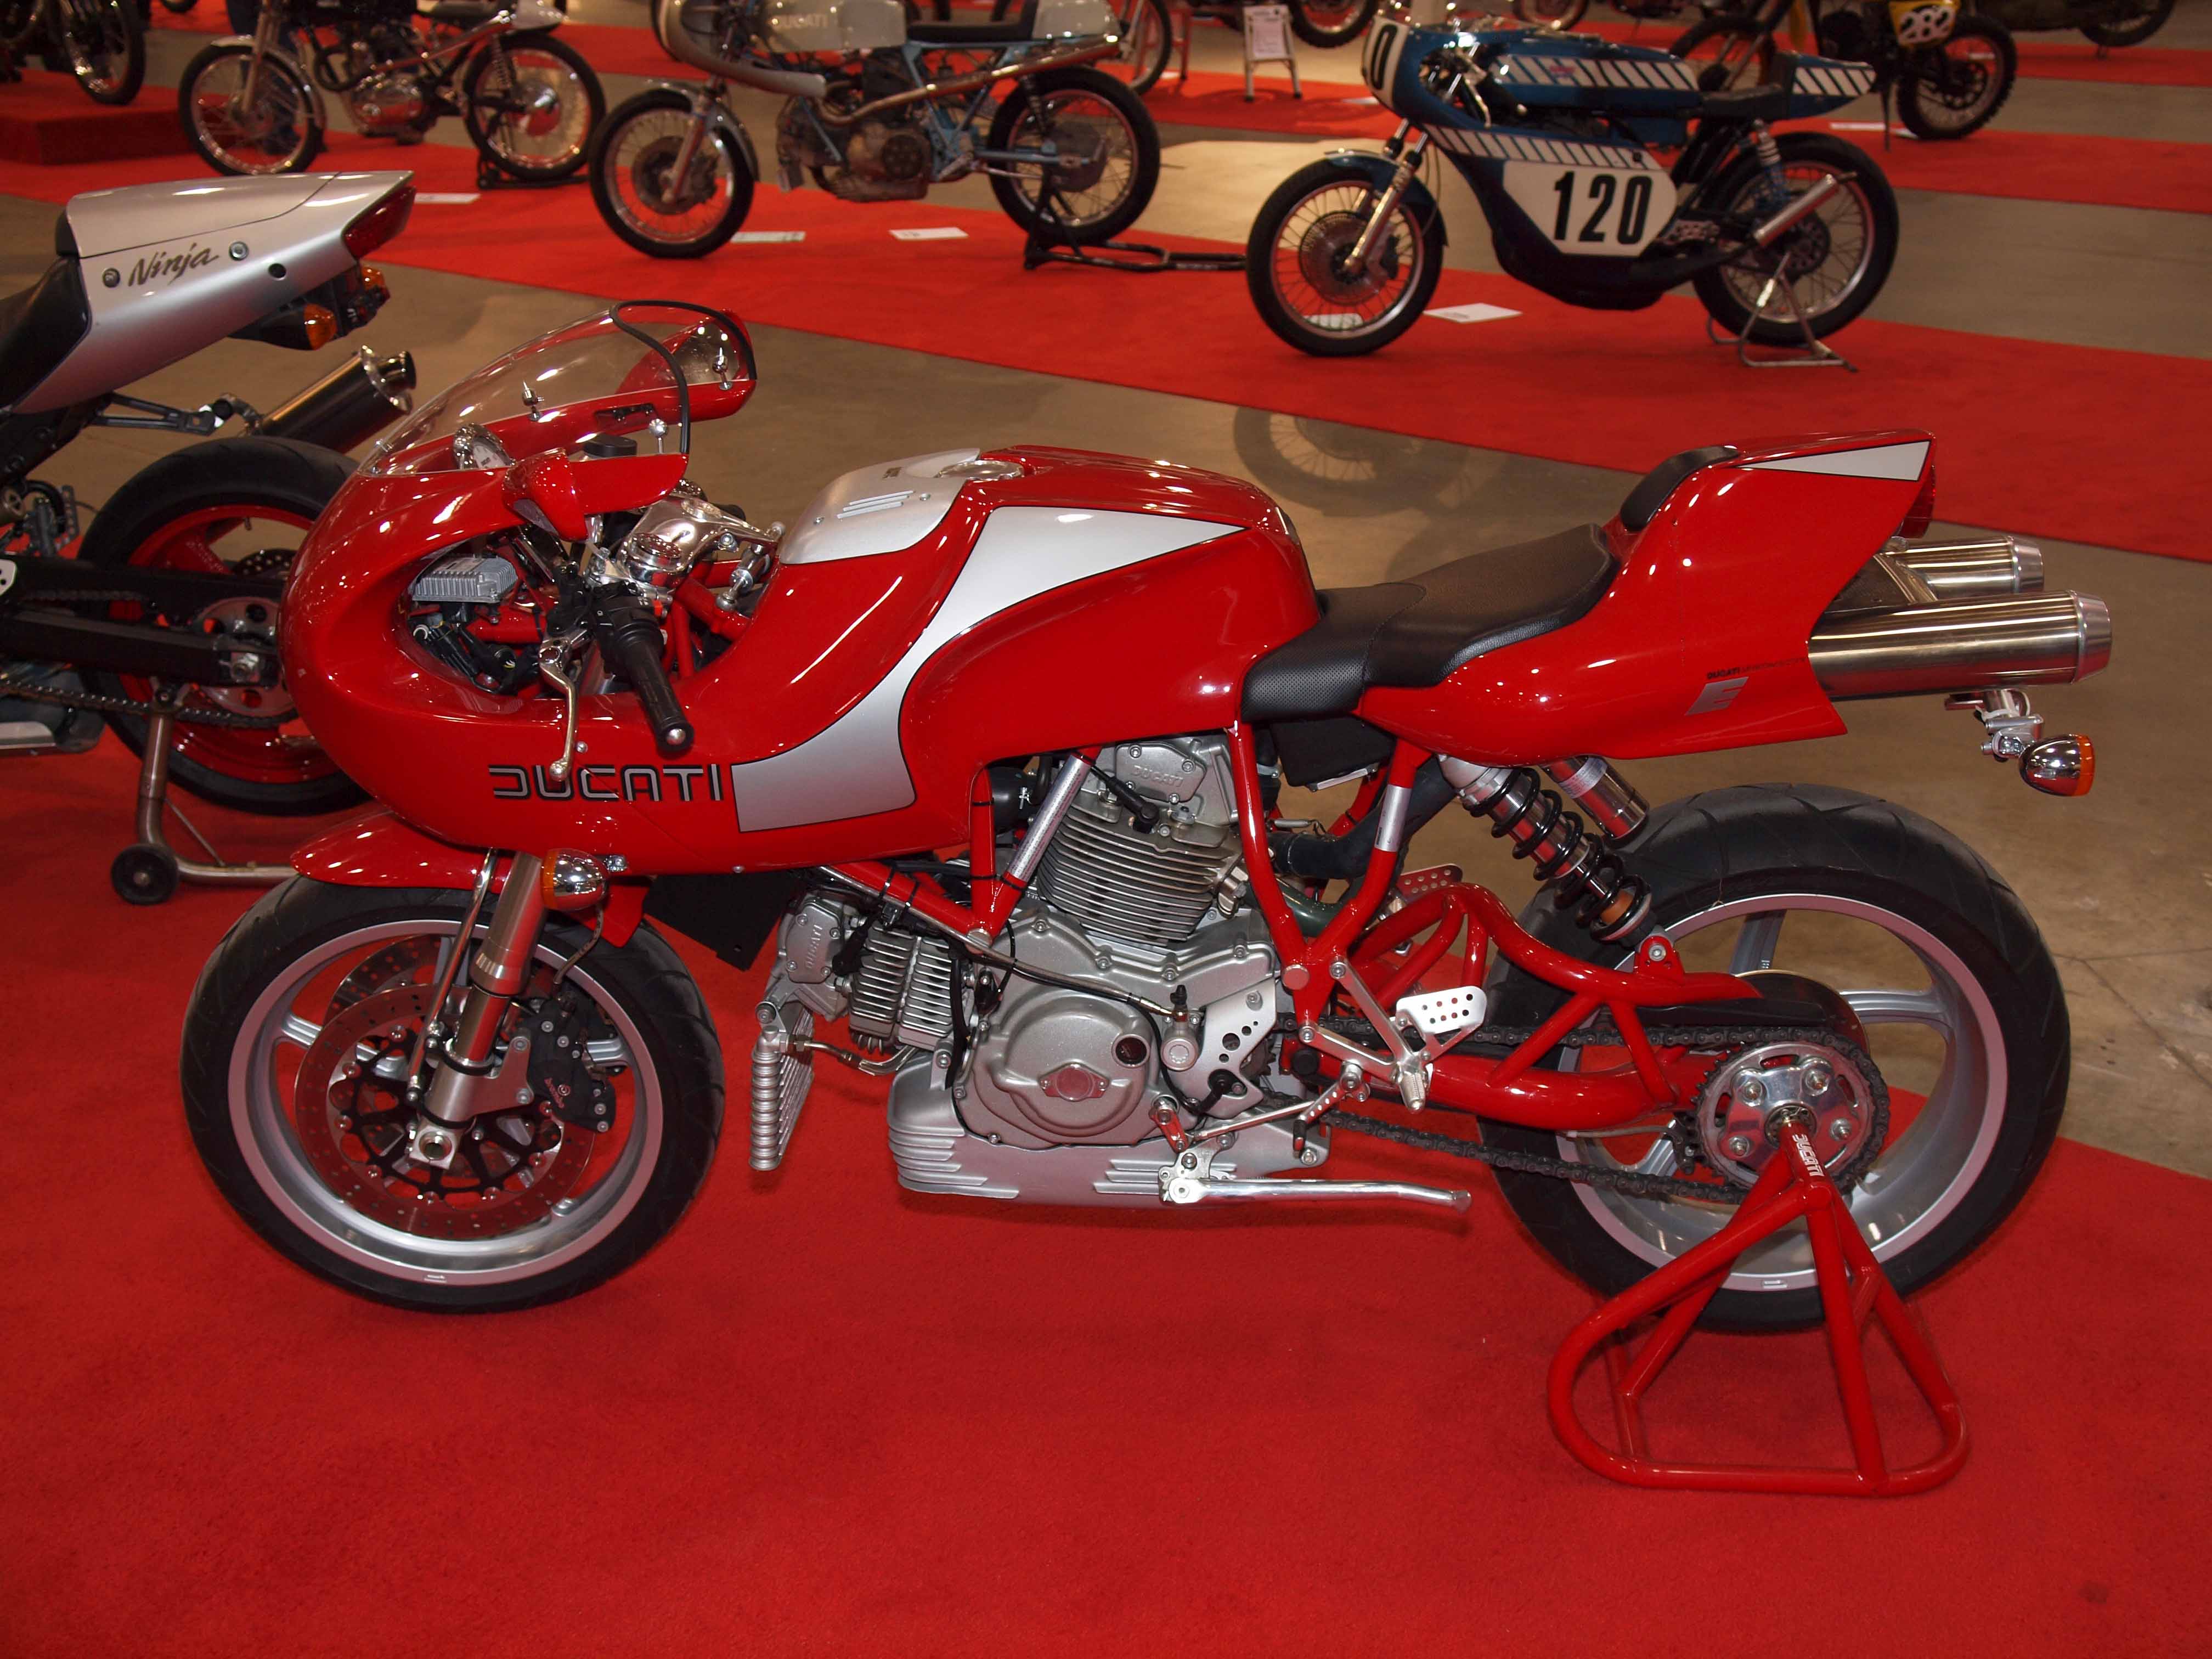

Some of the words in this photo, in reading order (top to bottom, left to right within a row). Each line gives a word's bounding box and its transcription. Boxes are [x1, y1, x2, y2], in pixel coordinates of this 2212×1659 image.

[1554, 171, 1654, 245] 120
[127, 242, 220, 286] Ninja
[488, 764, 723, 802] DUCATI
[1792, 1133, 1825, 1177] DUCATI
